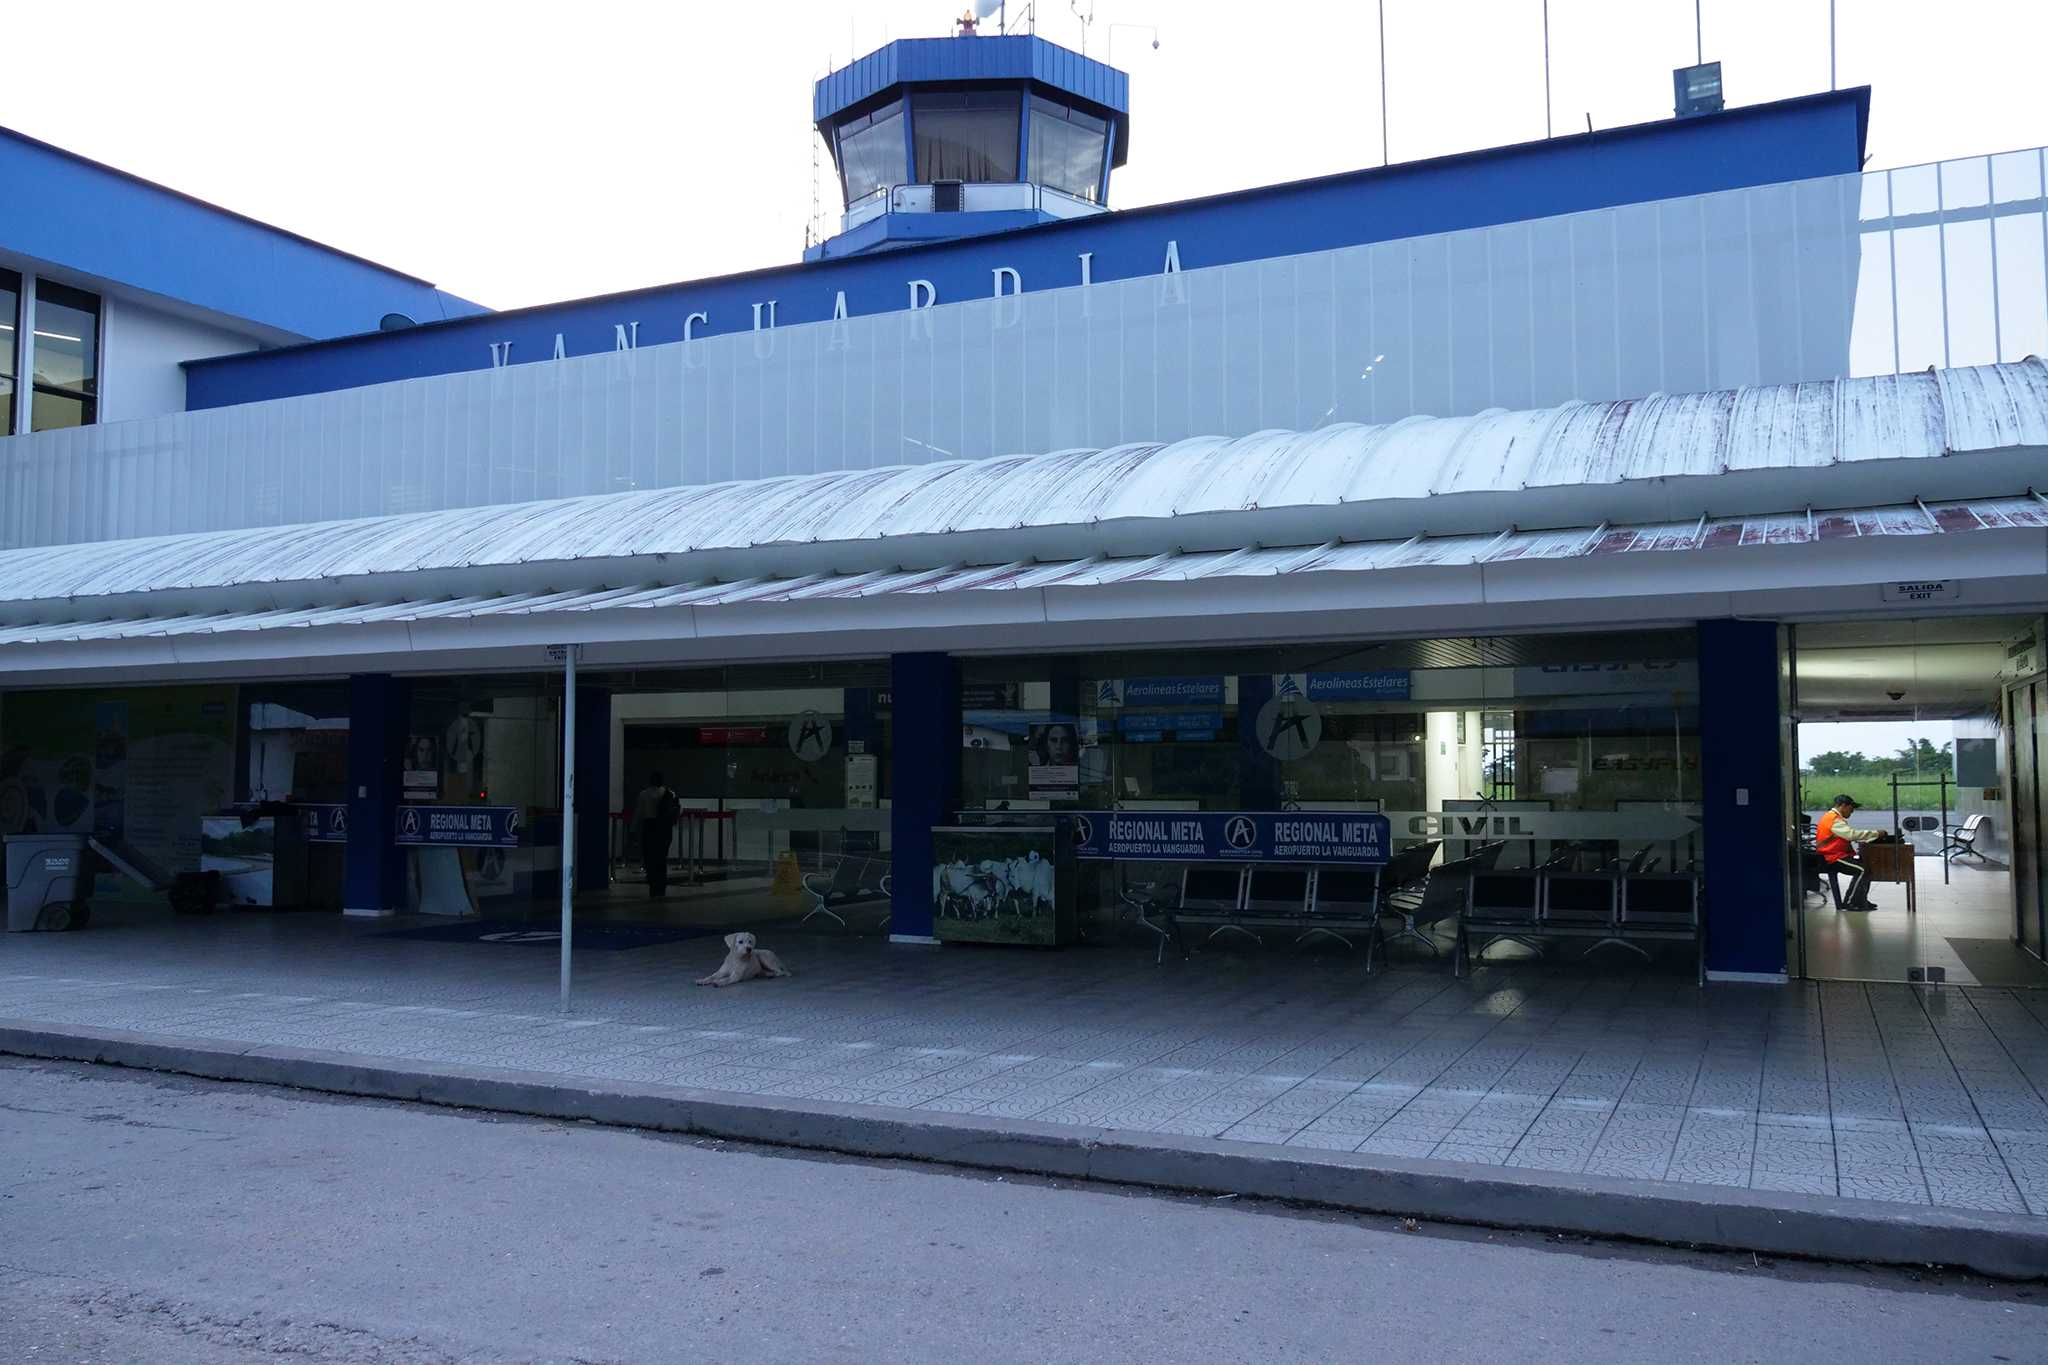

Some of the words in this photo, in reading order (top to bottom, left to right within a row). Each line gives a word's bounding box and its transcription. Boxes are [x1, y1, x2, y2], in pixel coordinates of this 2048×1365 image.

[488, 240, 1187, 385] VANGUARDIA
[1898, 583, 1944, 592] SALIDA
[430, 813, 469, 830] REGIONAL
[470, 814, 493, 831] META
[1108, 820, 1168, 841] REGIONAL
[1171, 821, 1204, 841] META
[1408, 816, 1534, 835] CIVIL
[1274, 821, 1339, 843] REGIONAL
[1342, 823, 1378, 844] META
[1108, 842, 1150, 853] AEROPUERTO
[1152, 843, 1162, 854] LA
[1162, 844, 1206, 855] VANGUARDIA
[1273, 844, 1320, 857] AEROPUERTO
[1321, 845, 1331, 857] LA
[1332, 845, 1380, 858] VANGUARDIA
